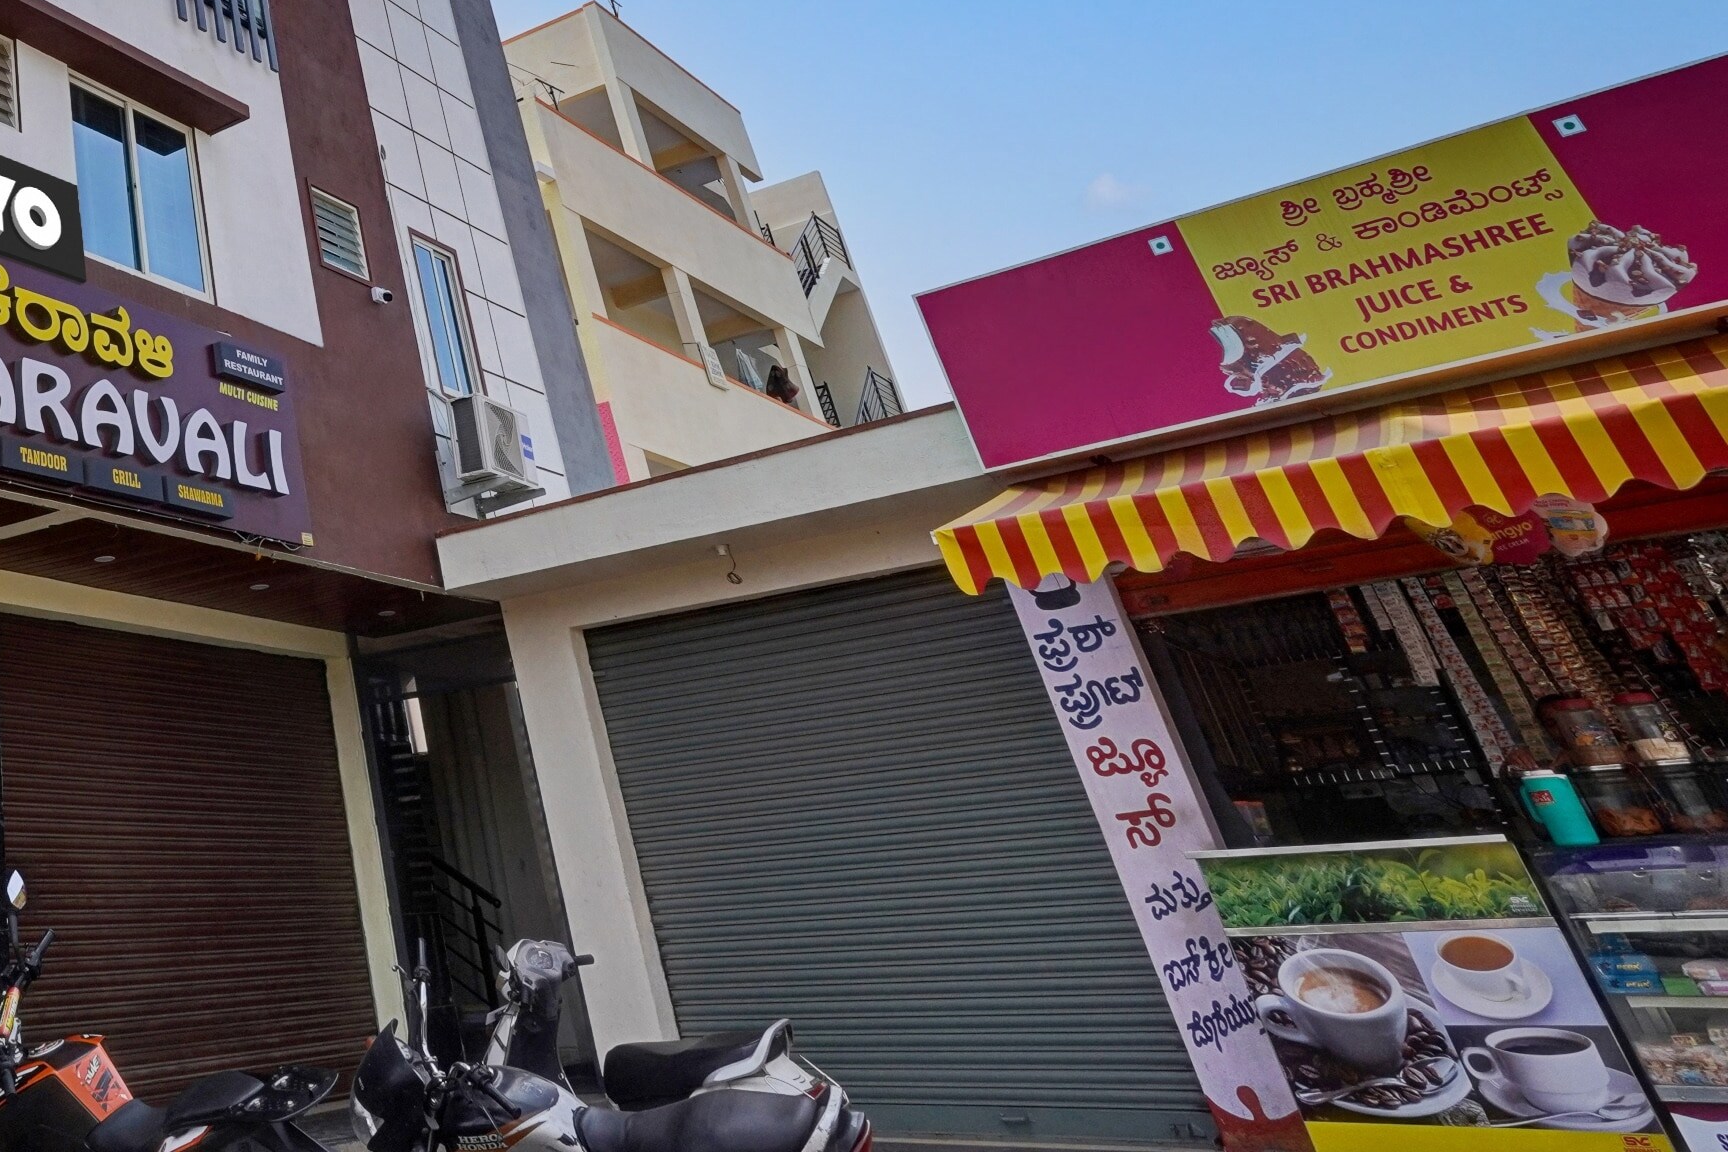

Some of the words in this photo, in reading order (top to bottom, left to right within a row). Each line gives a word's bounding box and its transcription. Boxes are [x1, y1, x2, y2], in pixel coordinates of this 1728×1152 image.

[1279, 196, 1321, 227] ಶ್ರೀ
[1332, 164, 1433, 211] ಬ್ರಹ್ಮಶ್ರೀ
[1211, 239, 1300, 281] ಜ್ಯೂಸ್
[1315, 232, 1343, 253] &
[1351, 168, 1564, 243] ಕಾಂಡಿಮೆಂಟ್ಸ್
[1252, 279, 1302, 308] SRI
[1304, 212, 1555, 295] BRAHMASHREE
[1355, 278, 1444, 323] JUICE
[1450, 274, 1474, 295] &
[1339, 294, 1529, 355] CONDIMENTS
[223, 358, 284, 387] RESTAURANT
[235, 349, 269, 368] FAMILY
[219, 381, 245, 402] MULTI
[246, 391, 279, 412] CUISINE
[19, 446, 68, 473] TANDOOR
[112, 468, 141, 490] GRILL
[177, 484, 224, 509] SHAWARMA
[1491, 520, 1534, 541] ngyo
[1145, 870, 1213, 921] ಮತ್ತು
[456, 1141, 509, 1151] HONDA
[457, 1133, 499, 1144] HERO
